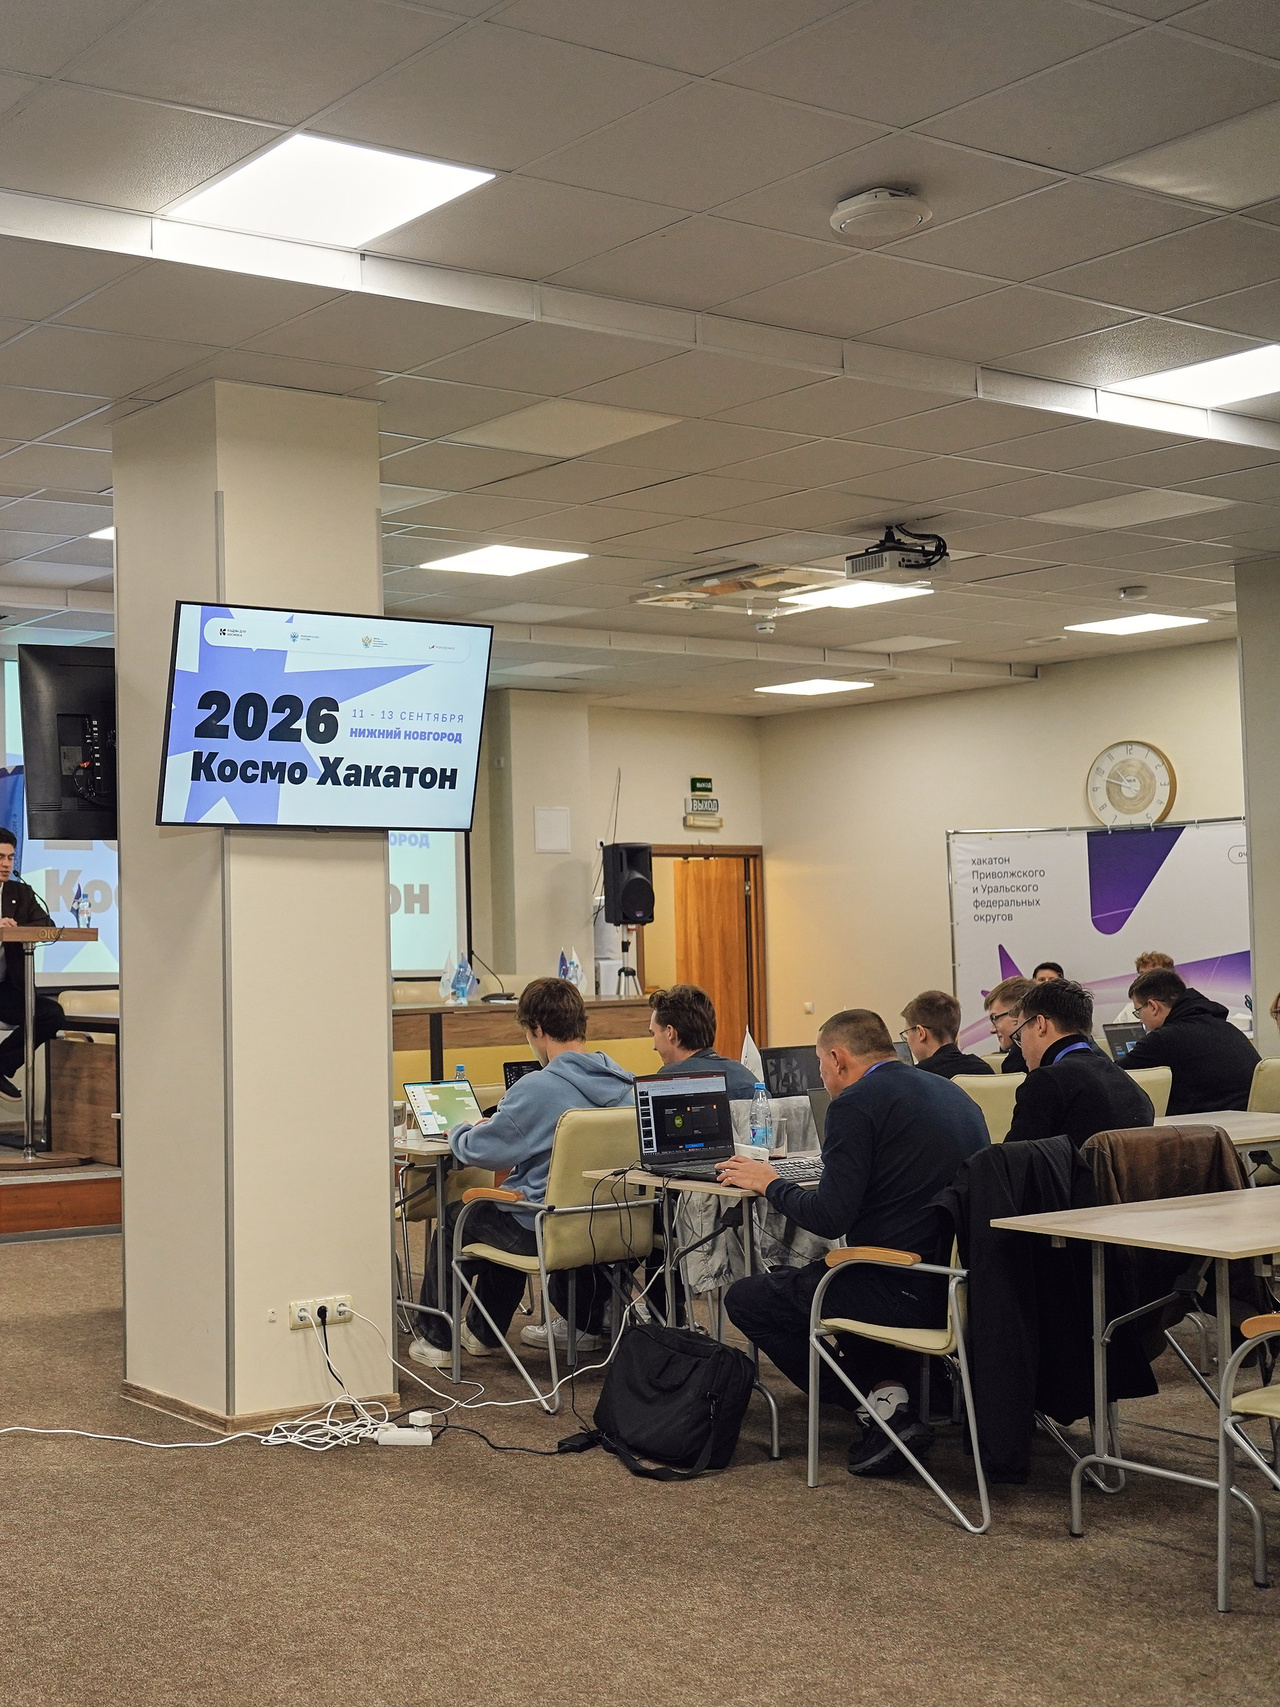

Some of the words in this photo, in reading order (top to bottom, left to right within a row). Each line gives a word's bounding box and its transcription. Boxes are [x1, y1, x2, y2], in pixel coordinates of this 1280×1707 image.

[194, 690, 340, 744] 2026
[352, 709, 364, 719] 11
[381, 710, 394, 720] 13
[400, 711, 464, 723] СЕНТЯБРЯ
[349, 727, 401, 740] НИЖНИЙ
[403, 730, 463, 744] НОВГОРОД
[190, 751, 309, 786] Космо
[316, 756, 458, 790] Хакатон
[693, 800, 717, 811] ВЫХОД
[389, 832, 431, 849] ОРОД
[970, 855, 1011, 867] хакатон
[971, 867, 1046, 881] Приволжского
[972, 885, 979, 895] и
[981, 883, 1039, 898] Уральского
[972, 897, 1041, 909] федеральных
[973, 912, 1013, 923] округов
